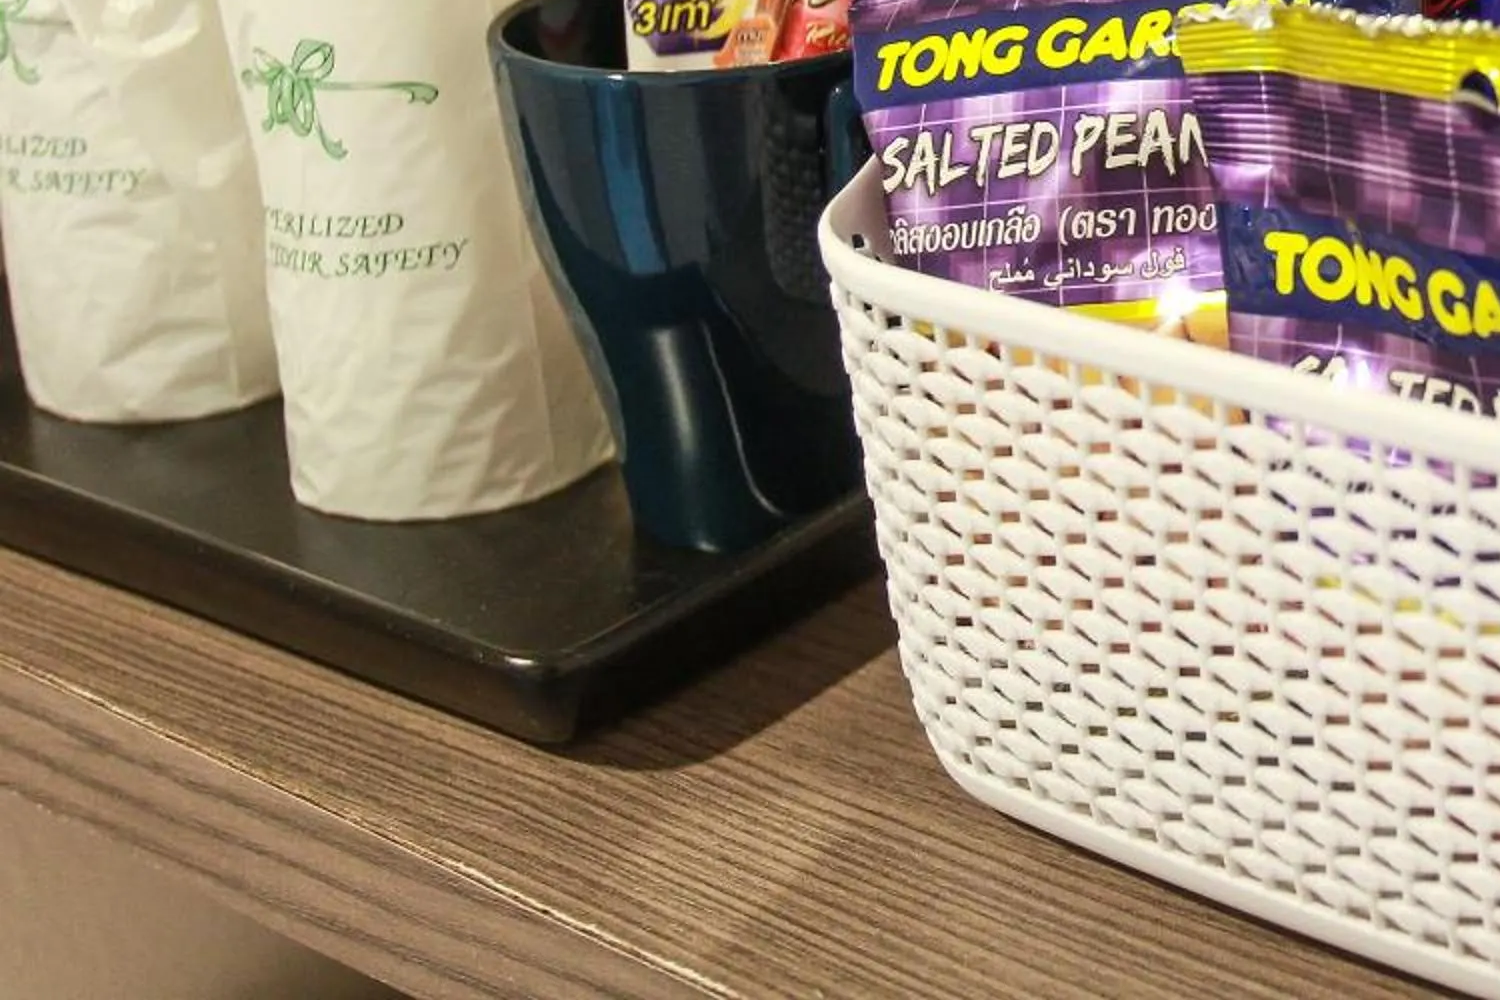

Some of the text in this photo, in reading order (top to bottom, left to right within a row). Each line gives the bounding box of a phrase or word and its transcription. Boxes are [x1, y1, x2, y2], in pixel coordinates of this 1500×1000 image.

[876, 25, 1029, 91] TONG
[0, 136, 88, 158] LIZED
[881, 109, 1210, 196] SALTED PEAN
[336, 236, 469, 279] SAFETY
[1263, 231, 1424, 321] TONG
